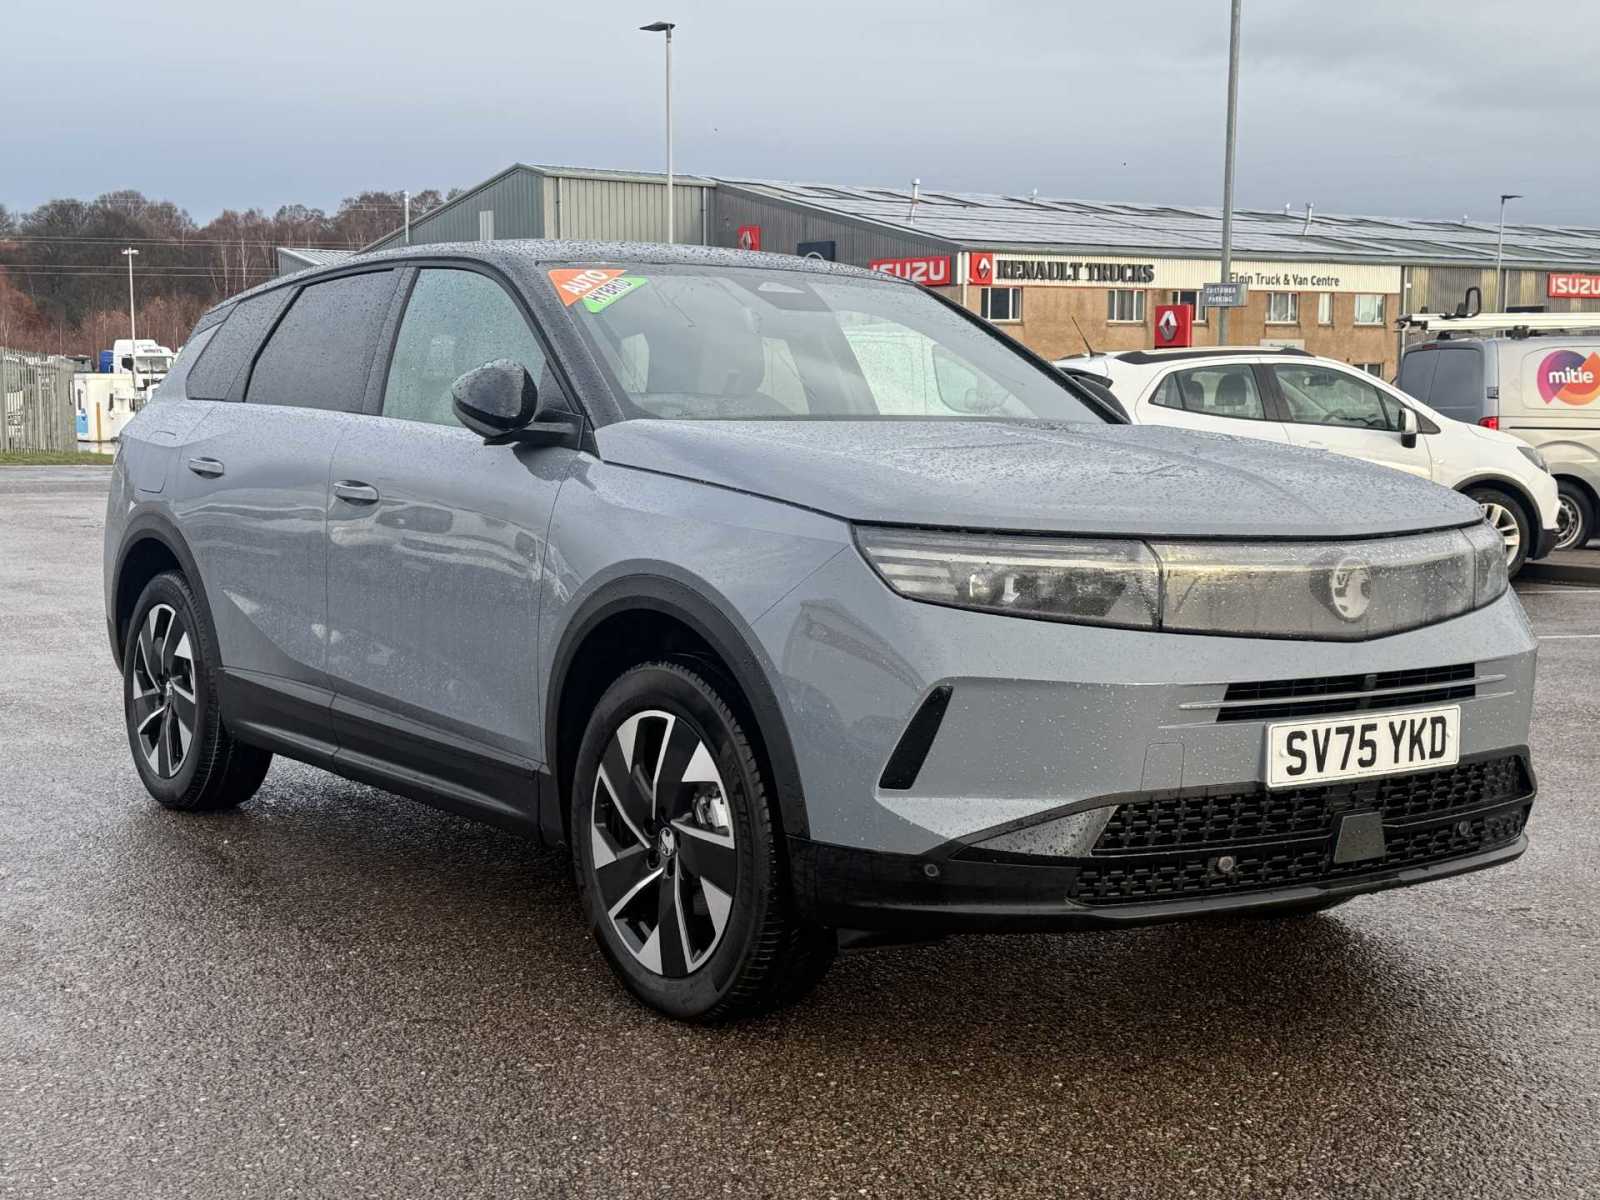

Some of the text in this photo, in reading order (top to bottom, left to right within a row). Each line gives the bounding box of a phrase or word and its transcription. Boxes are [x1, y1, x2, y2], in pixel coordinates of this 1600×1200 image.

[561, 269, 609, 296] AUTO
[997, 259, 1155, 283] RENAULT TRUCKS
[1255, 273, 1280, 286] Truck
[1283, 274, 1290, 285] &
[1292, 274, 1308, 286] Van
[1310, 275, 1340, 287] Centre
[588, 278, 633, 304] HYBRID
[1552, 277, 1600, 295] ISUZU
[1548, 367, 1594, 384] mitie
[1286, 715, 1447, 776] SV75 YKD
